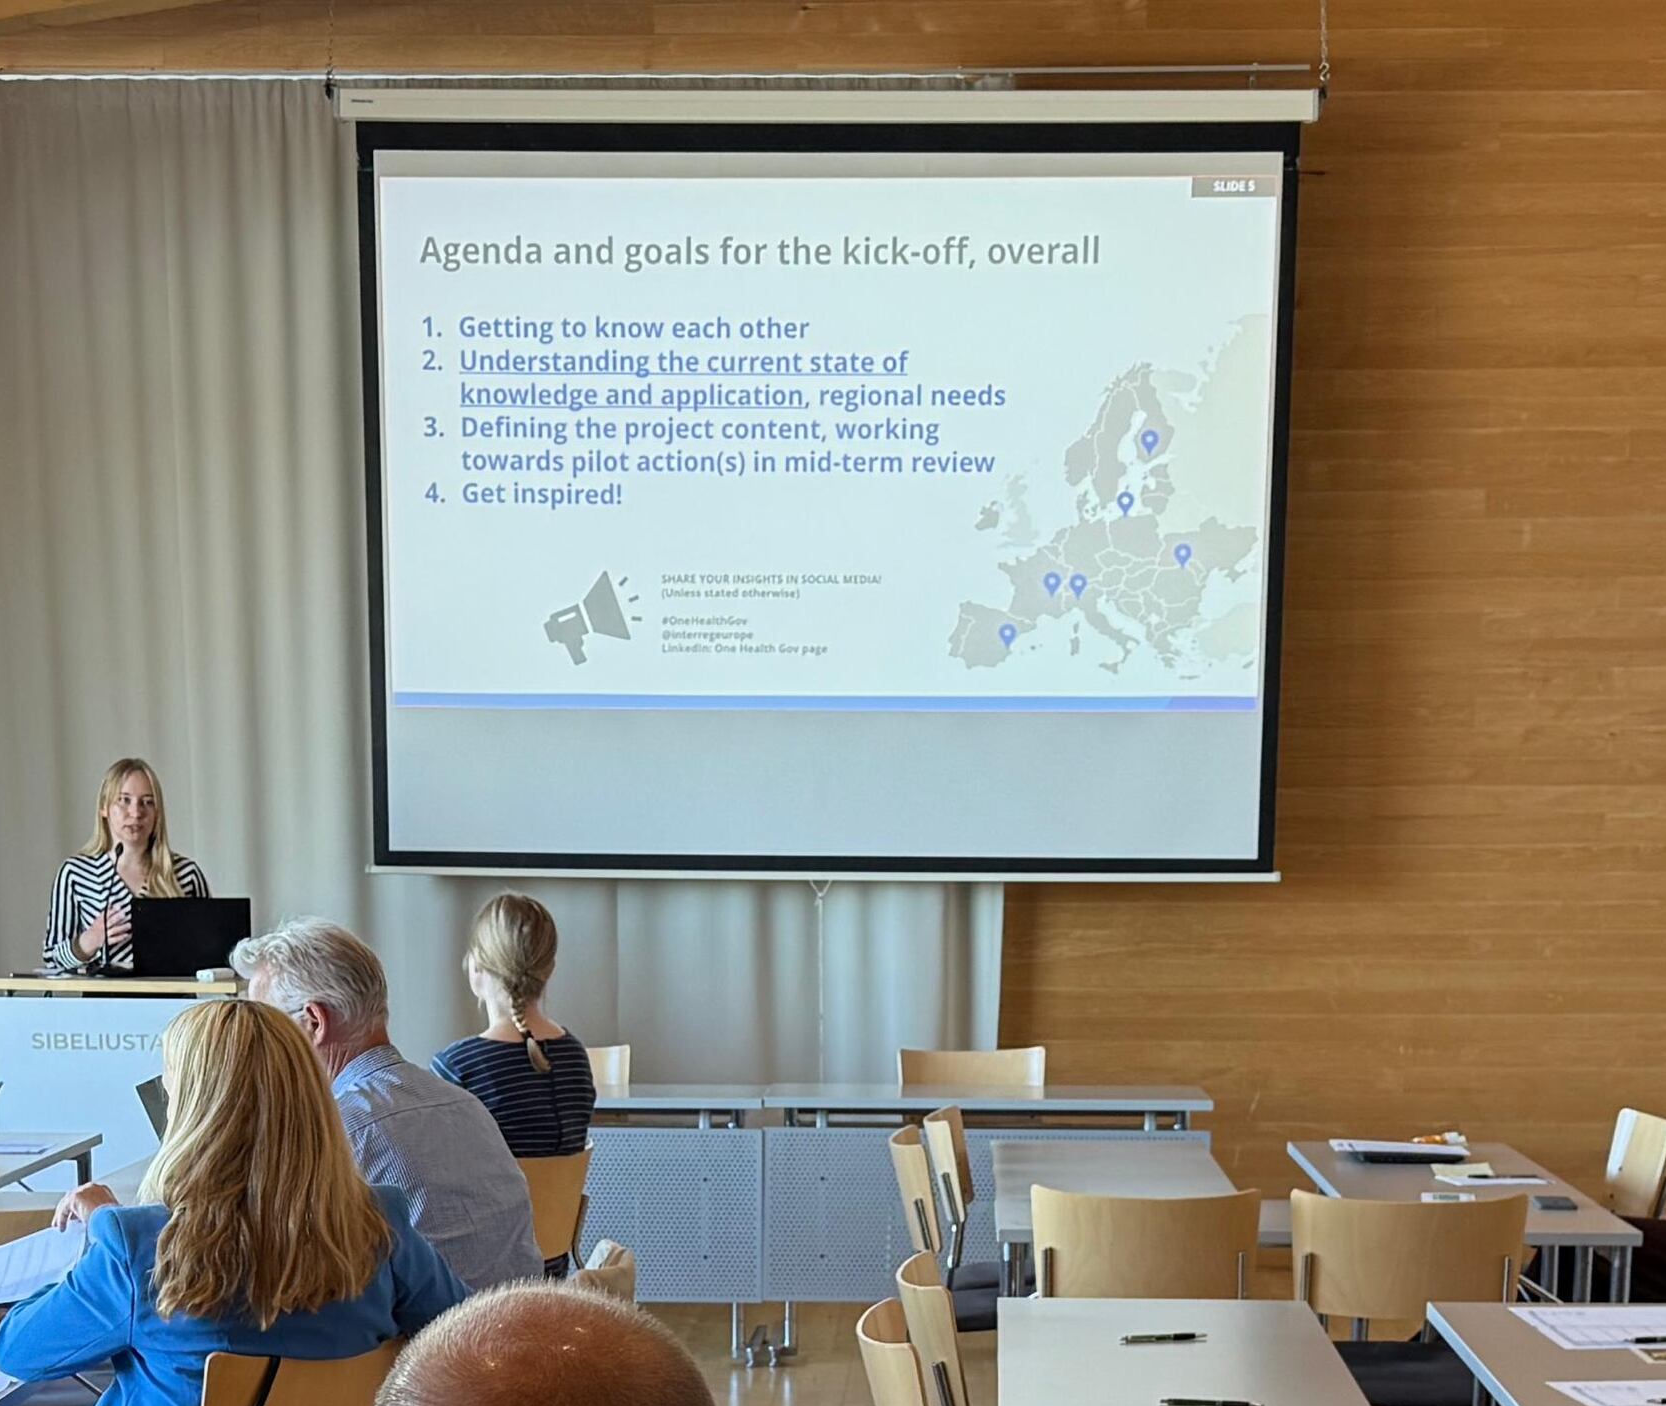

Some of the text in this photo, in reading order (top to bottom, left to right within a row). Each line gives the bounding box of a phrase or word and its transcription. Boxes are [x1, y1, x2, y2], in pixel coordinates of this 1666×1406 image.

[1213, 180, 1256, 192] SLIDE 5
[420, 235, 1100, 273] Agenda and goals for the kick-off, overall
[422, 315, 810, 344] 1. Getting to know each other
[422, 349, 909, 378] 2. Understanding the current state of
[460, 382, 1006, 412] knowledge and application, regional needs
[423, 416, 940, 446] 3. Defining the project content, working
[462, 449, 996, 478] towards pilot action(s) in mid-term review
[424, 482, 622, 511] 4. Get inspired!
[661, 574, 883, 585] SHARE YOUR INSIGHTS IN SOCIAL MEDIA!
[661, 588, 801, 600] (Unless stated otherwise)
[661, 643, 829, 657] LinkedIn: One Health Gov page
